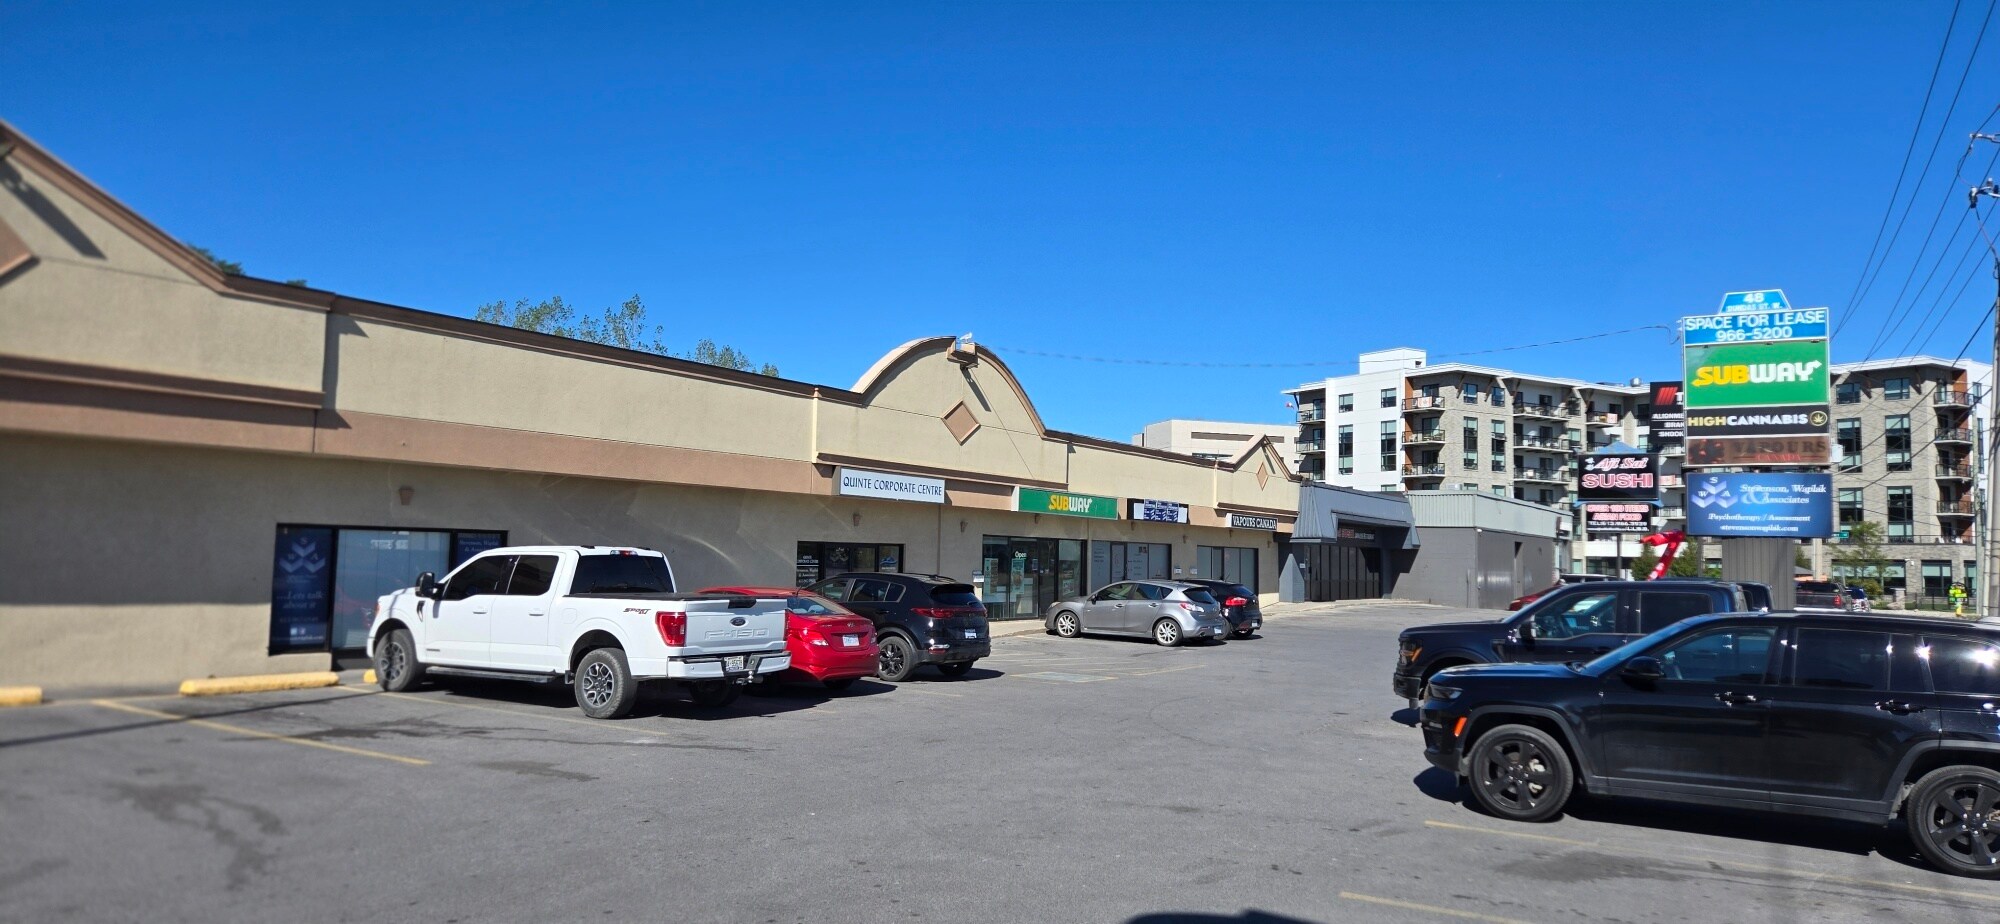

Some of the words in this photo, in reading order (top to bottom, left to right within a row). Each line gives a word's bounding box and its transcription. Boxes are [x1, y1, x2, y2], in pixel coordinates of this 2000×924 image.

[1743, 293, 1764, 303] 48
[1686, 316, 1732, 331] SPACE
[1738, 314, 1769, 328] FOR
[1775, 310, 1826, 325] LEASE
[1715, 326, 1793, 342] 966-5200
[1691, 360, 1822, 387] SUBWAY
[1732, 440, 1827, 454] VAPOURS
[843, 476, 872, 489] QUINTE
[873, 479, 916, 494] CORPORATE
[917, 484, 942, 496] CENTRE
[1581, 473, 1654, 488] SUSHI
[1698, 490, 1709, 498] W
[1740, 484, 1790, 494] Stevenson,
[1049, 494, 1093, 513] SUBWAY
[1232, 516, 1256, 528] VAPOURS
[1255, 518, 1277, 530] CANADA
[1014, 551, 1028, 559] Open
[704, 628, 769, 641] F-150
